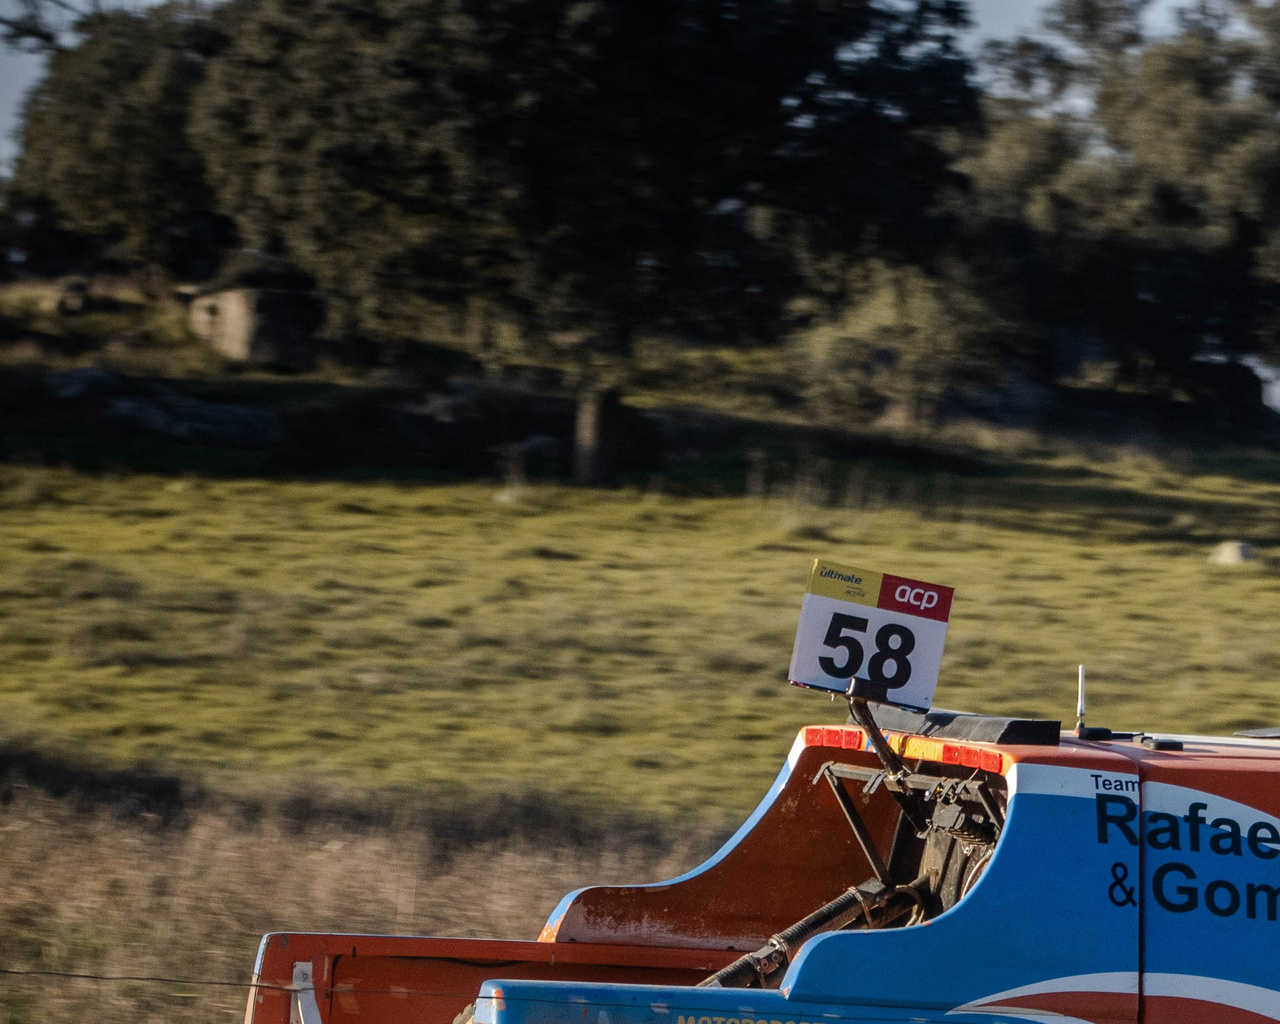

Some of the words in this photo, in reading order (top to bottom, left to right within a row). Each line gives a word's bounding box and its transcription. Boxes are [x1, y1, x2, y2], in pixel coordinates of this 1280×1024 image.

[819, 569, 863, 585] ultimate
[894, 585, 939, 610] acp
[818, 611, 916, 690] 58
[1090, 774, 1139, 792] Team
[1108, 862, 1137, 907] &
